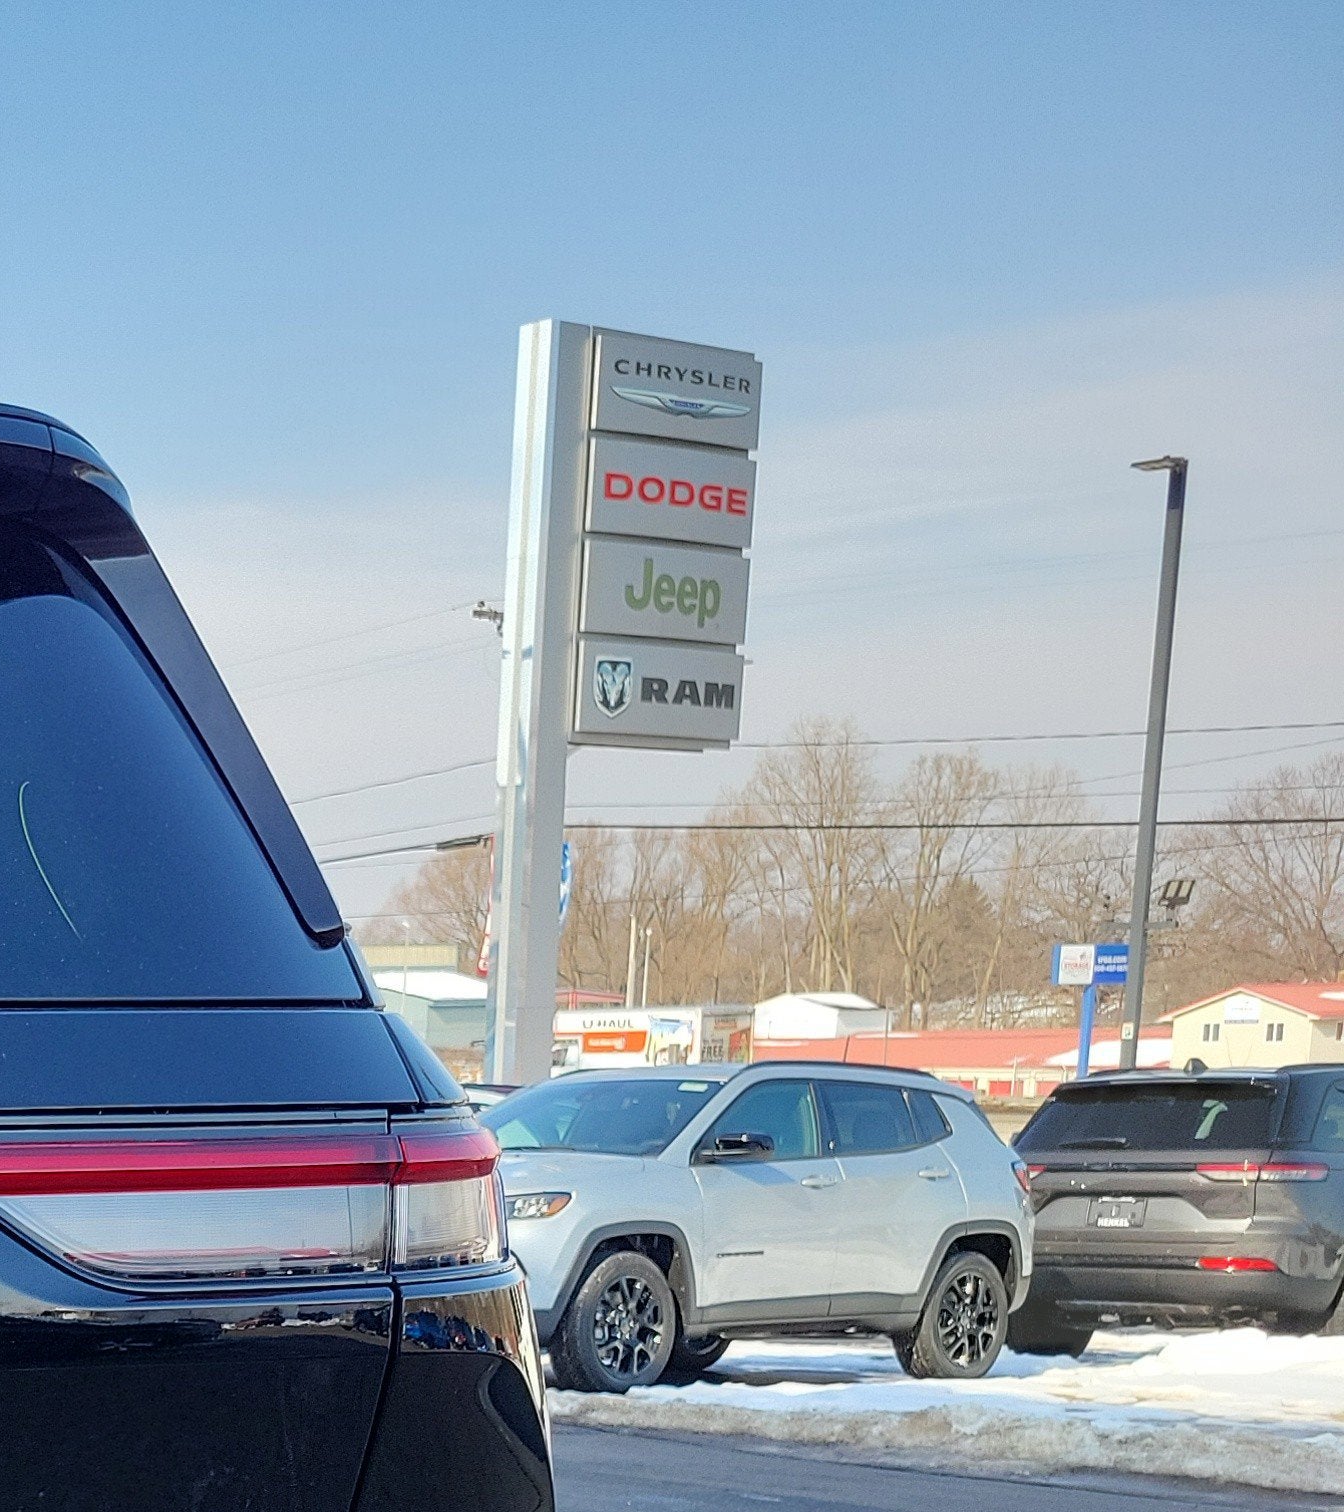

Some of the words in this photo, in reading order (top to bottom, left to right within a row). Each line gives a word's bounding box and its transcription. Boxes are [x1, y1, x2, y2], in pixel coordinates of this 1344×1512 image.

[613, 358, 752, 395] CHRYSLER
[603, 471, 748, 517] DODGE
[624, 557, 722, 628] Jeep
[640, 676, 736, 711] RAM
[582, 1018, 635, 1029] UHAUL
